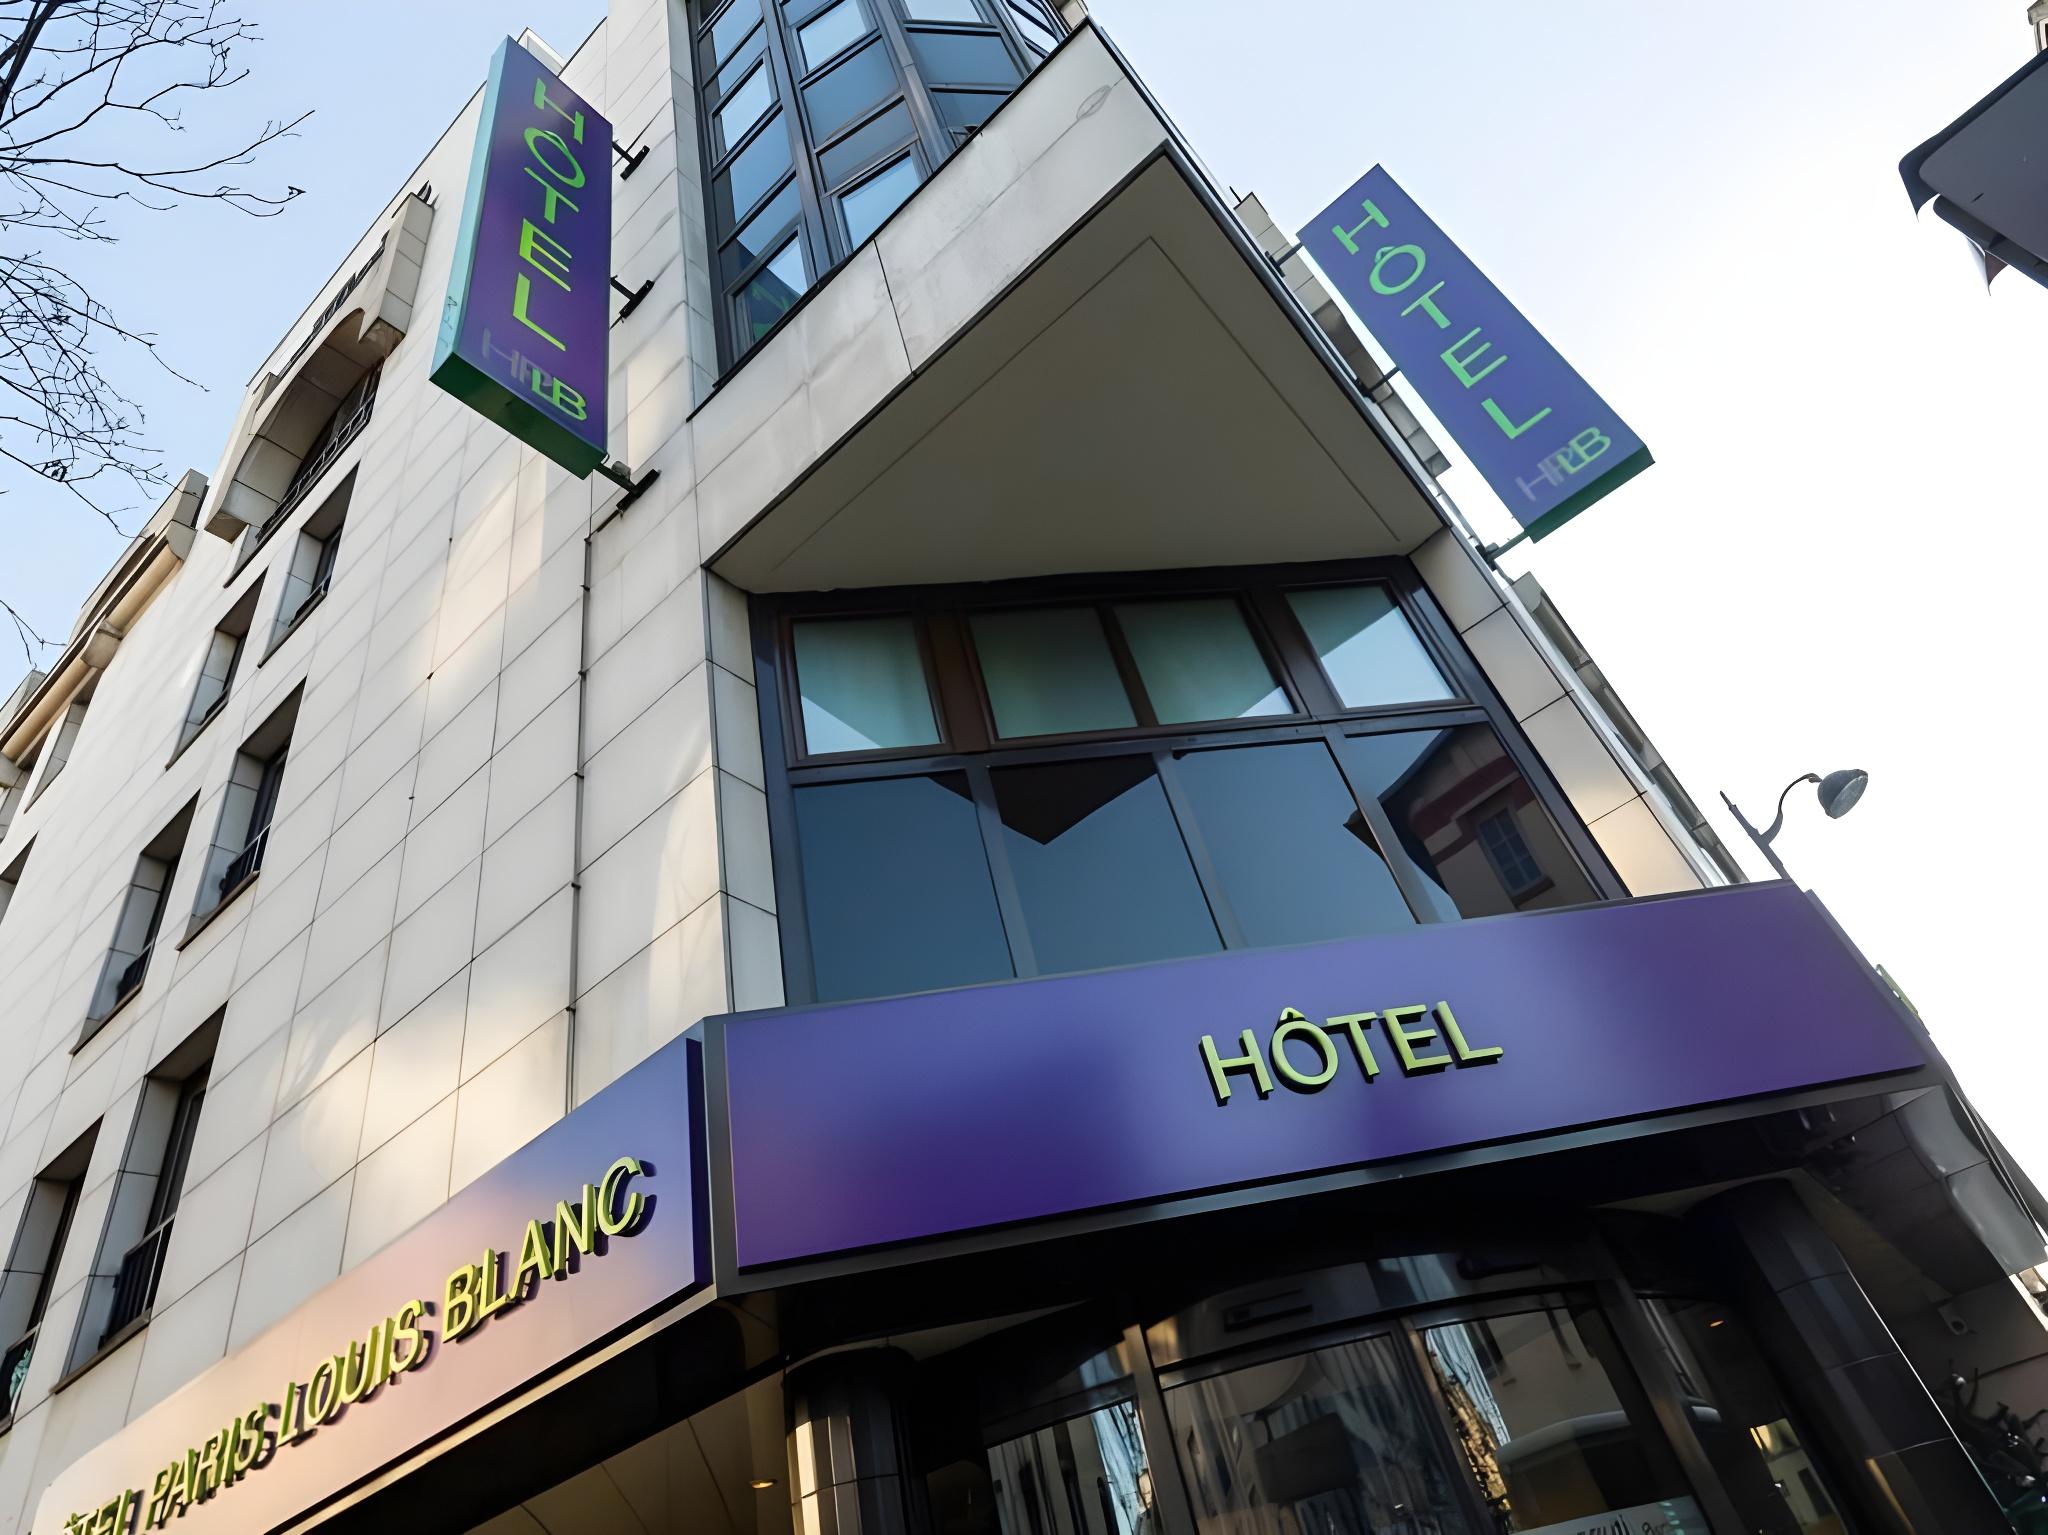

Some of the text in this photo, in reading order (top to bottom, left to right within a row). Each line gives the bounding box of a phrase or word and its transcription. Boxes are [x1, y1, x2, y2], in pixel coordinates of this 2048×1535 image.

[513, 78, 586, 352] HÔTEL
[1331, 199, 1552, 440] HÔTEL
[1200, 1000, 1504, 1101] HÔTEL
[145, 1402, 269, 1531] PARIS
[276, 1300, 427, 1448] LOUIS
[442, 1156, 645, 1344] BLANC
